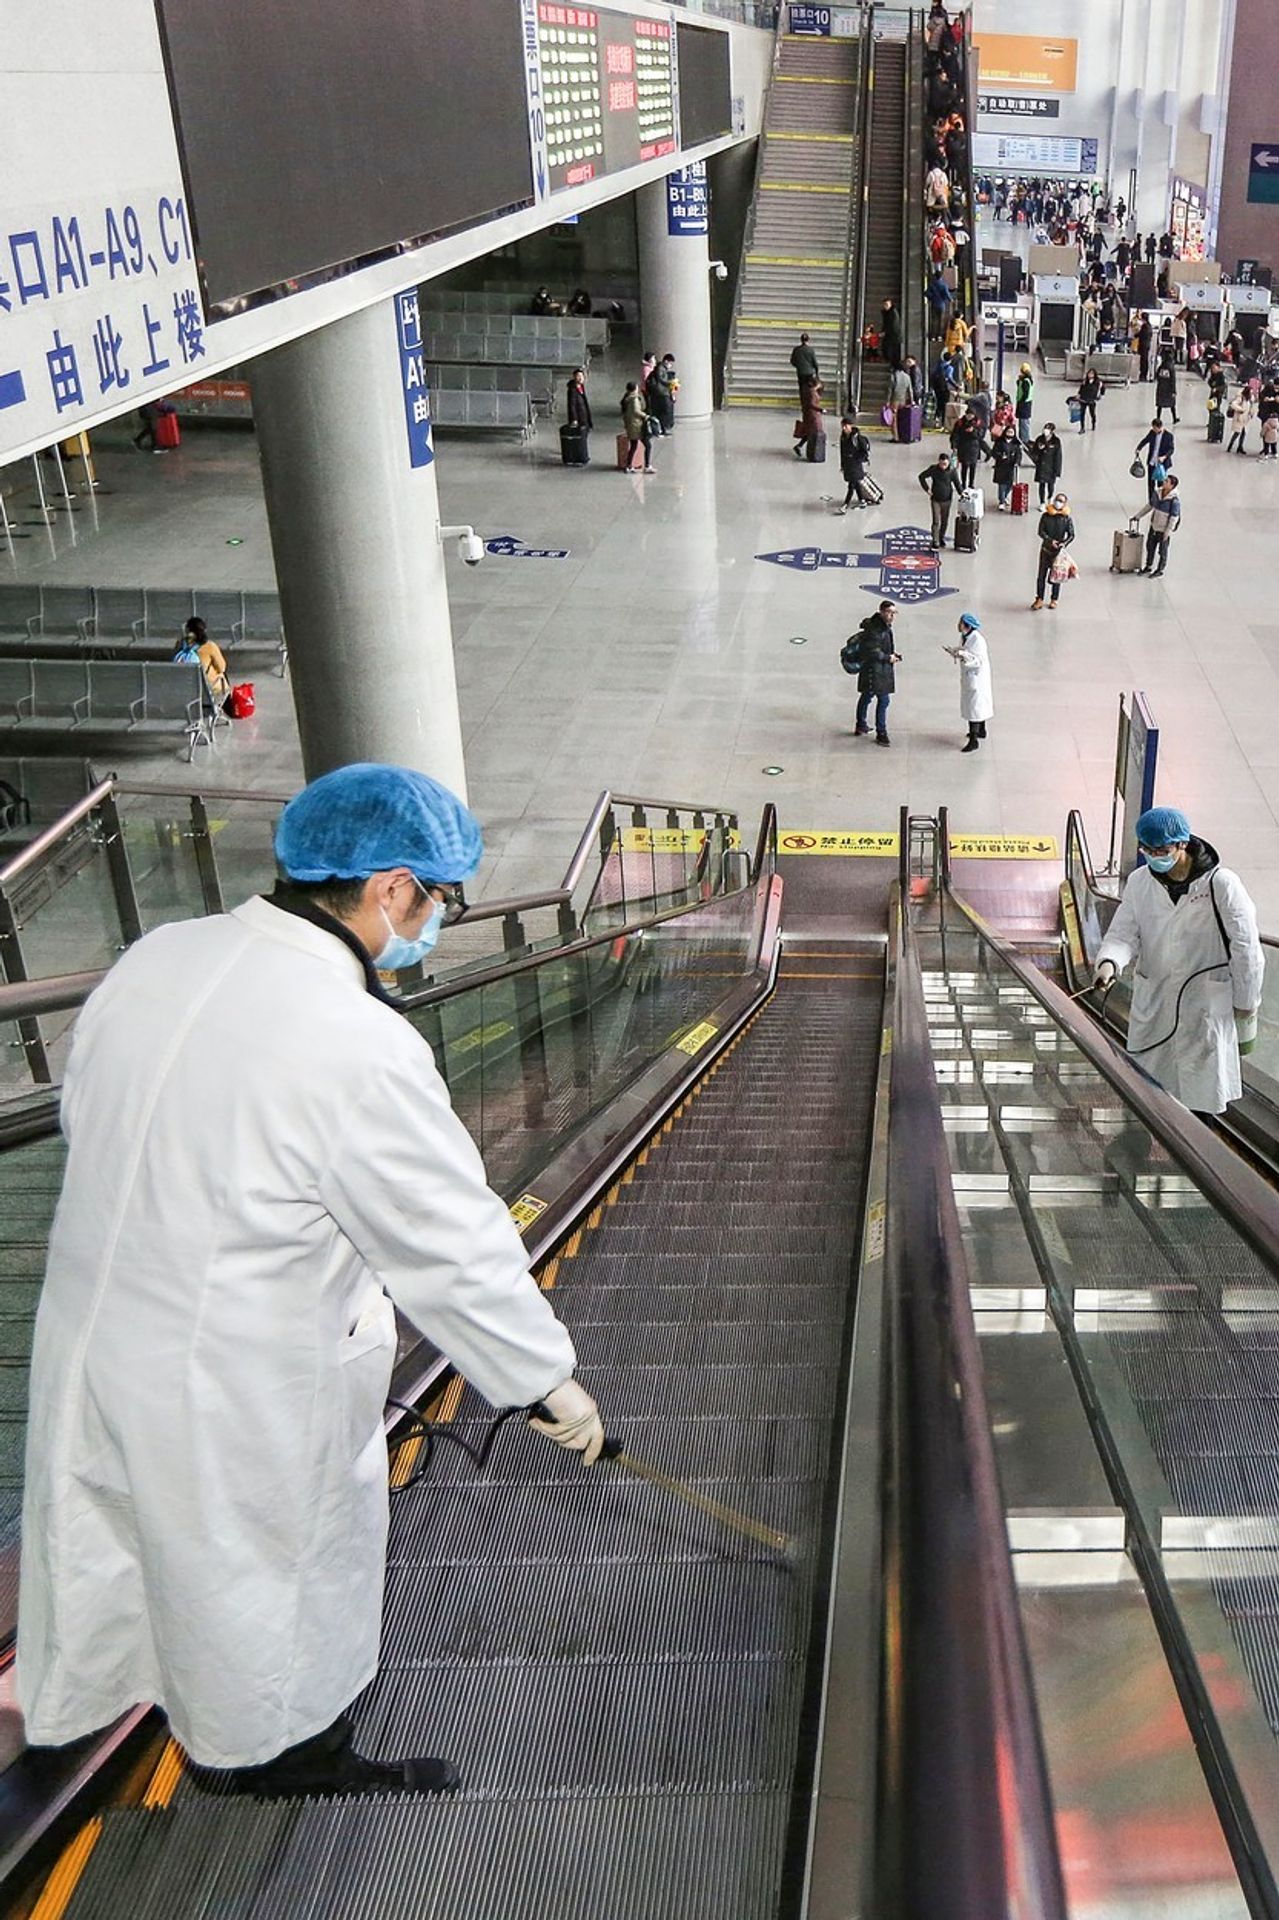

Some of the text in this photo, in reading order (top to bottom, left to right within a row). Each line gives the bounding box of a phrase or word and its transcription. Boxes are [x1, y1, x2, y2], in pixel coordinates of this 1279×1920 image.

[814, 10, 829, 25] 10
[46, 288, 206, 414] 由此上楼
[406, 354, 427, 390] A1
[821, 836, 894, 846] 禁止停留
